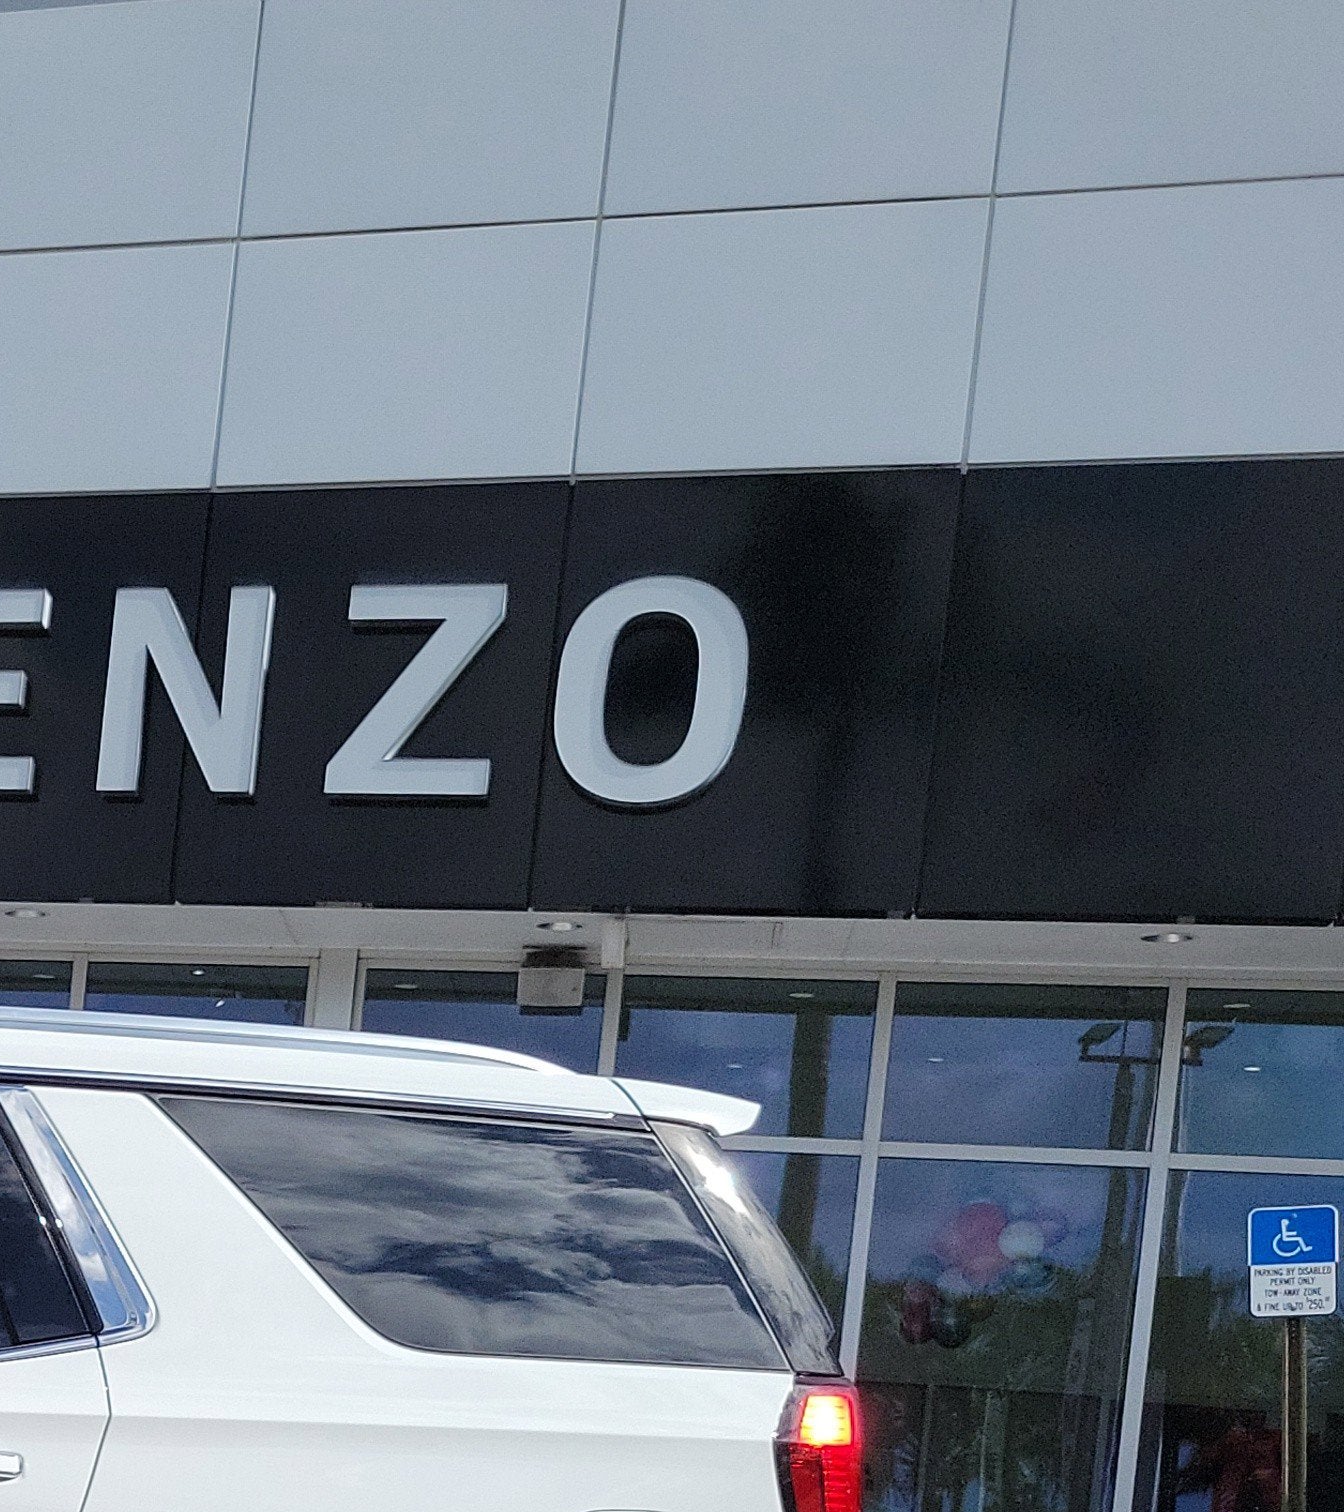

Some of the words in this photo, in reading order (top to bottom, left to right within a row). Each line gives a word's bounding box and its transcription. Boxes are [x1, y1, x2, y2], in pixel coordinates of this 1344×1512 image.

[1254, 1268, 1283, 1277] PARKING
[1286, 1267, 1296, 1276] BY
[1298, 1266, 1332, 1275] DISABLED
[1270, 1278, 1295, 1286] PERMIT
[1297, 1276, 1316, 1285] ONLY
[1303, 1287, 1321, 1297] ZONE
[1264, 1302, 1279, 1311] FINE
